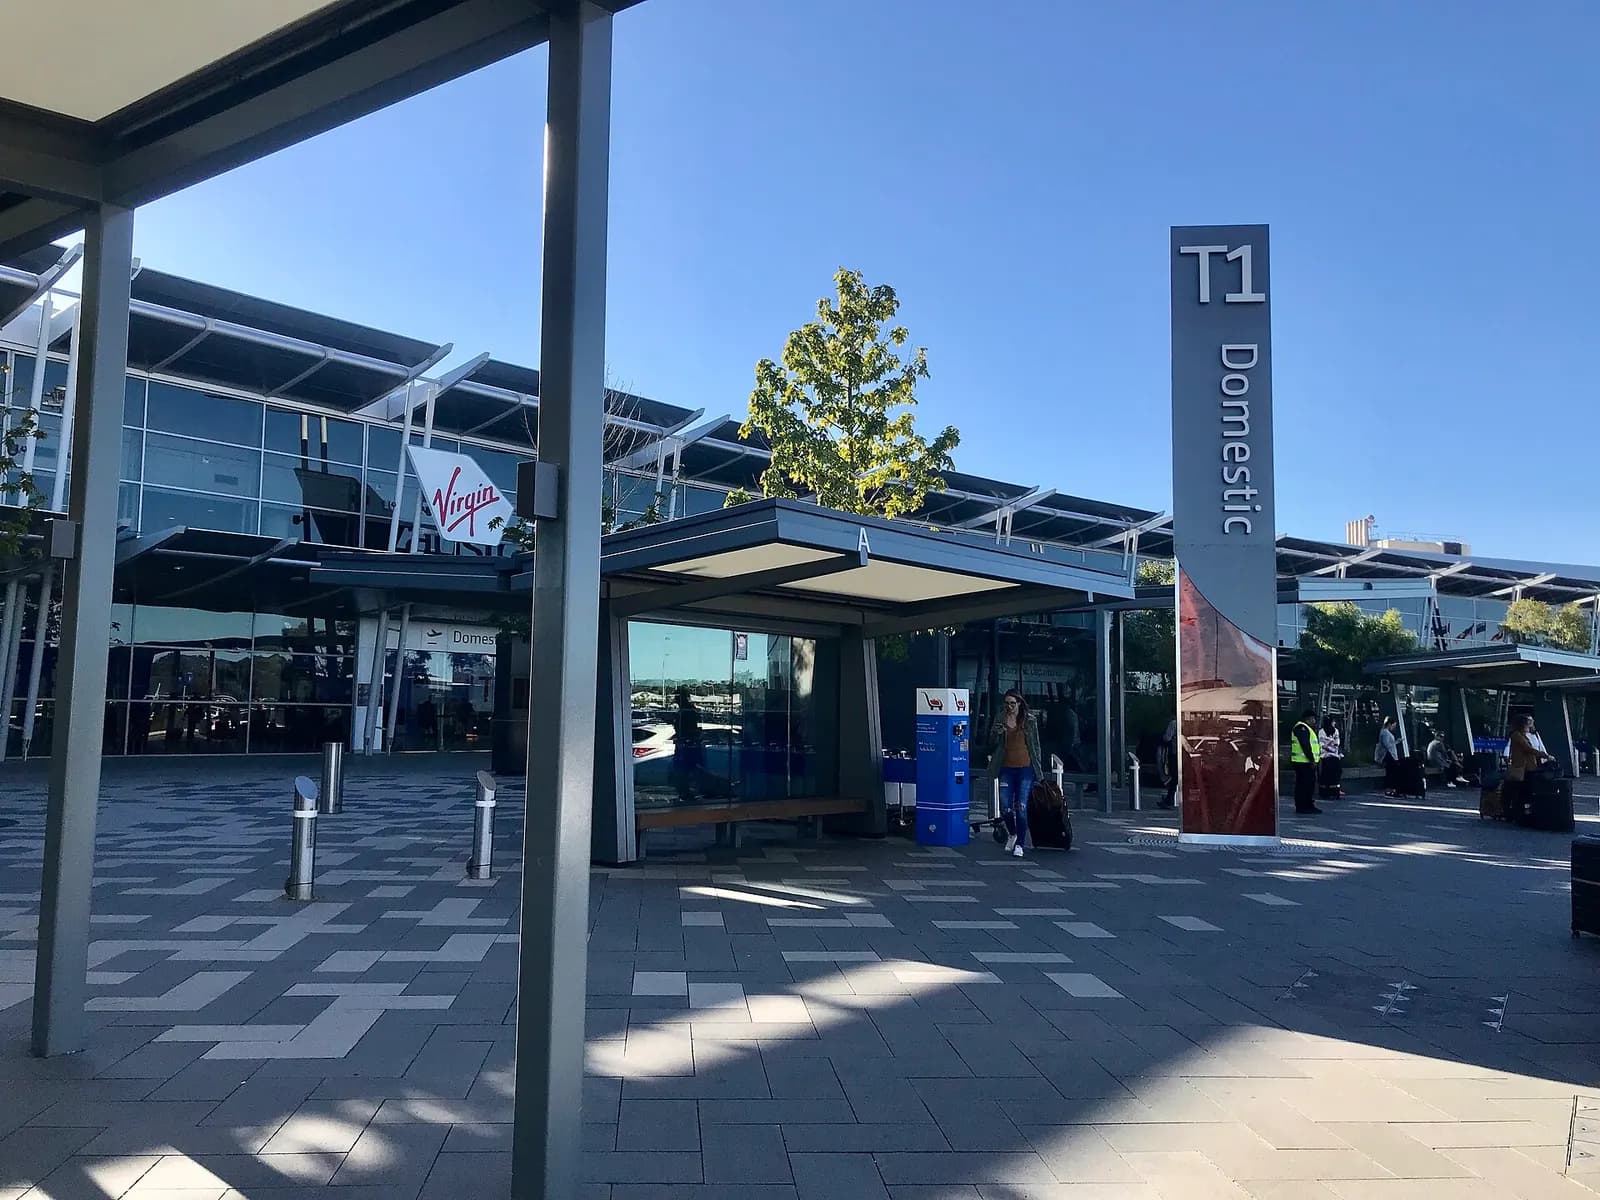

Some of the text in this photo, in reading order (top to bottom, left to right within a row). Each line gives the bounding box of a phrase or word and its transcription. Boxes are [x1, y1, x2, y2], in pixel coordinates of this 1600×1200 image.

[1179, 244, 1266, 303] T1
[1221, 343, 1262, 534] Domestic
[432, 466, 500, 537] Virgin
[857, 526, 871, 553] A
[453, 630, 497, 646] Domes
[1379, 678, 1391, 694] B
